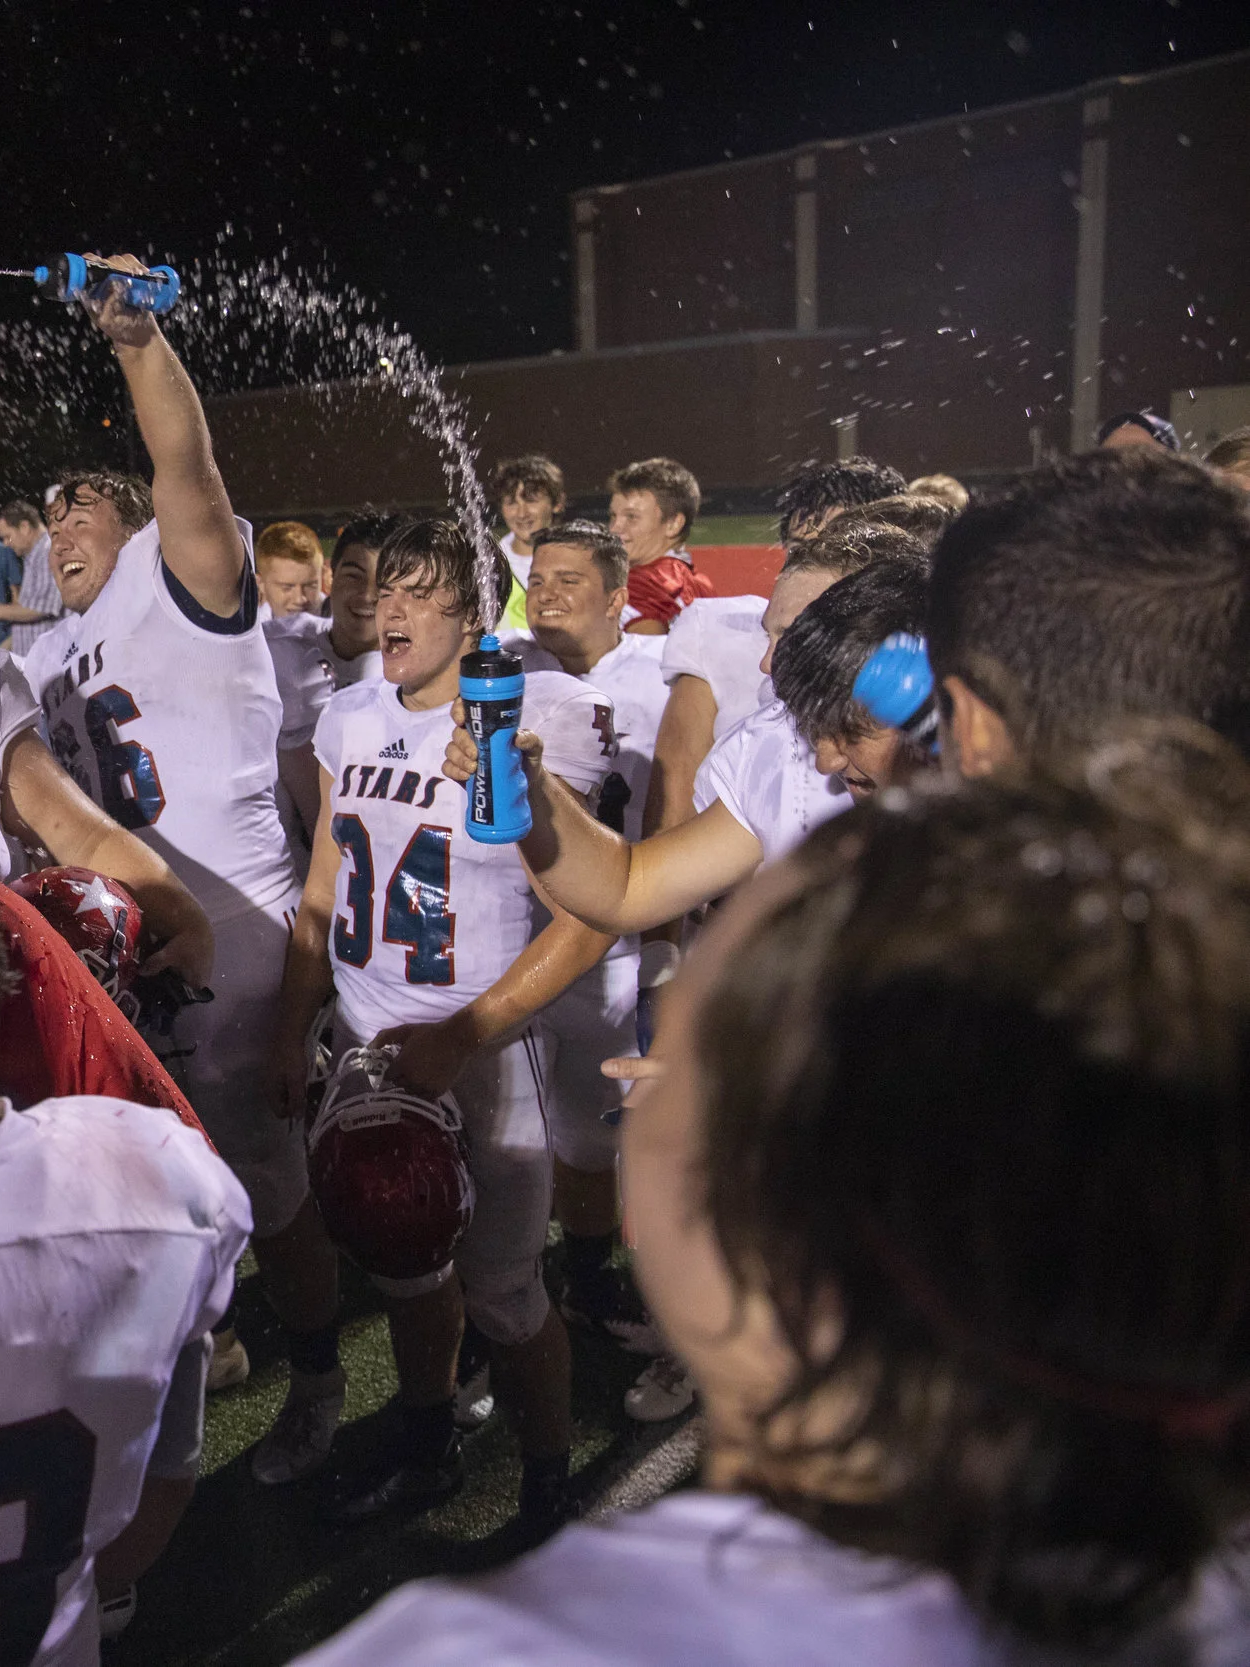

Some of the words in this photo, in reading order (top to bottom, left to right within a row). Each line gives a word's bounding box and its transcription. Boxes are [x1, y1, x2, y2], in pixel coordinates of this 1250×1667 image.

[338, 764, 446, 809] STARS
[378, 749, 409, 760] adidas
[470, 705, 487, 823] POWEDE
[331, 812, 456, 986] 34
